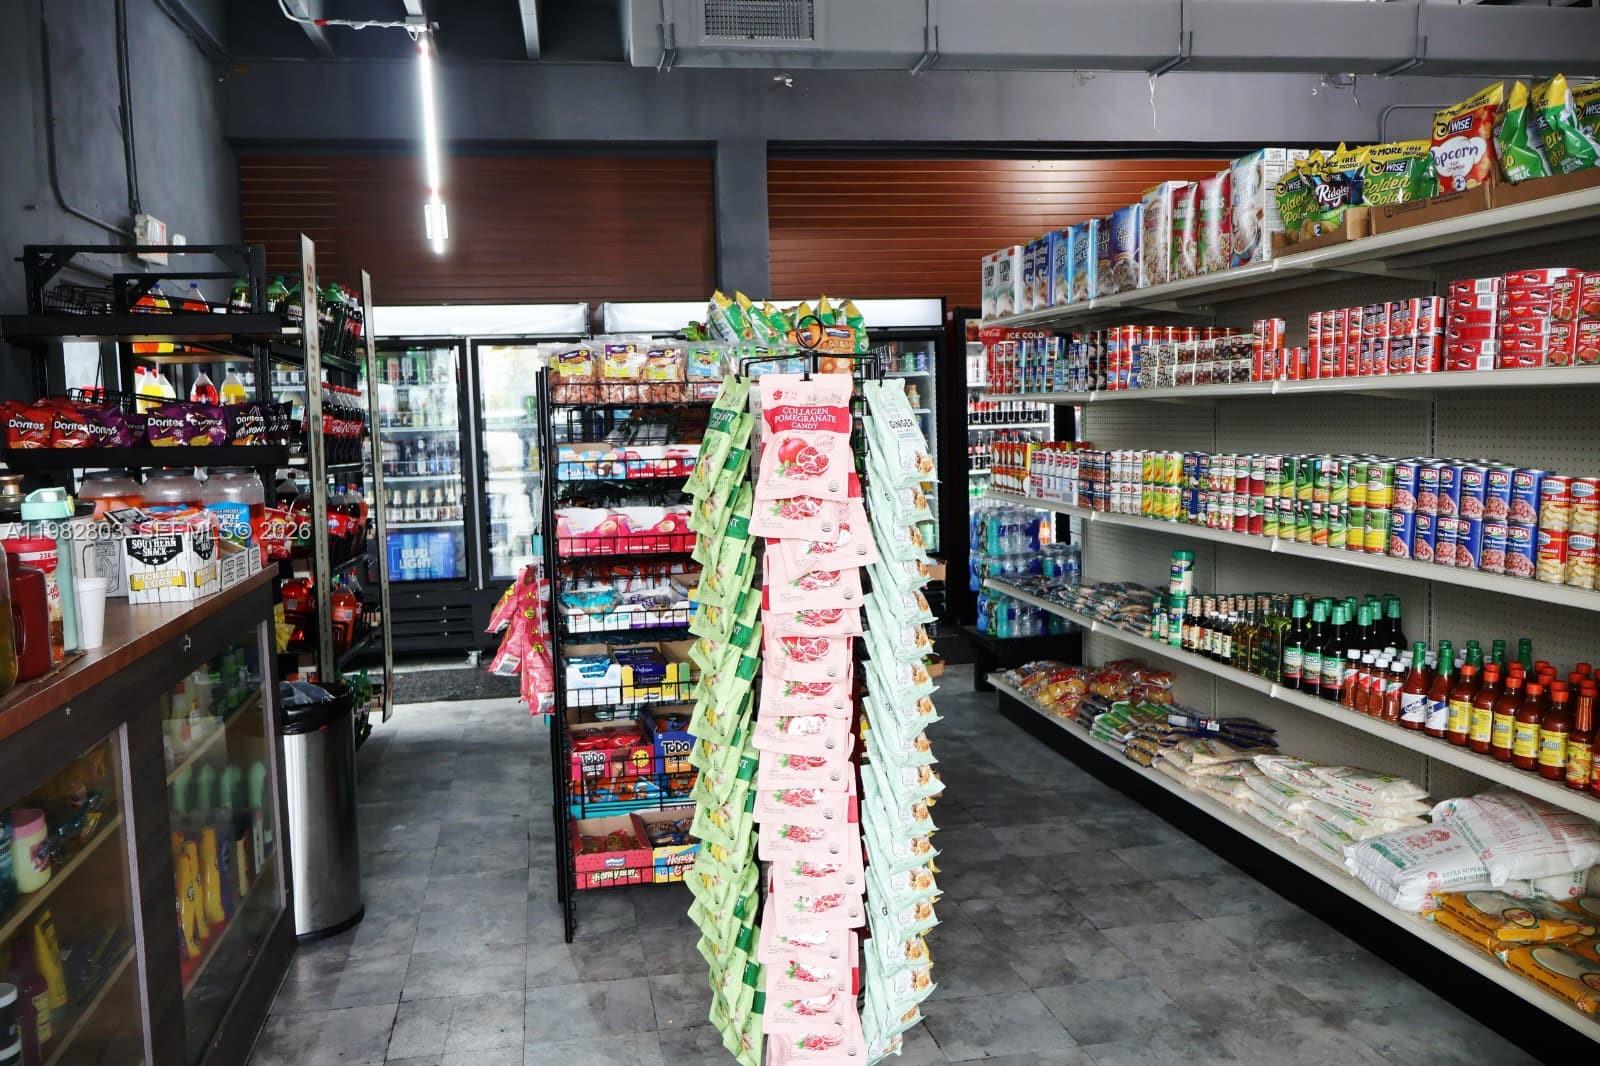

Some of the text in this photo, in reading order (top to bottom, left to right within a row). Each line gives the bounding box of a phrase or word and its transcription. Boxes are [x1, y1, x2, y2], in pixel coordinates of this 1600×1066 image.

[1450, 118, 1472, 132] WISE
[1377, 147, 1403, 156] MORE
[1386, 162, 1406, 172] WISE
[1288, 181, 1302, 191] WISE
[1022, 331, 1045, 339] COLD
[782, 407, 829, 416] COLLAGEN
[148, 417, 185, 427] Doritos
[236, 416, 264, 425] Doritos
[774, 414, 837, 424] POMEGRANATE
[889, 418, 914, 429] GINGER
[8, 419, 45, 431] Doritos
[89, 424, 118, 435] Doritos
[791, 421, 819, 430] CANDY
[132, 537, 176, 550] SOUTHERN
[401, 548, 428, 559] BUD
[399, 558, 431, 570] LIGHT
